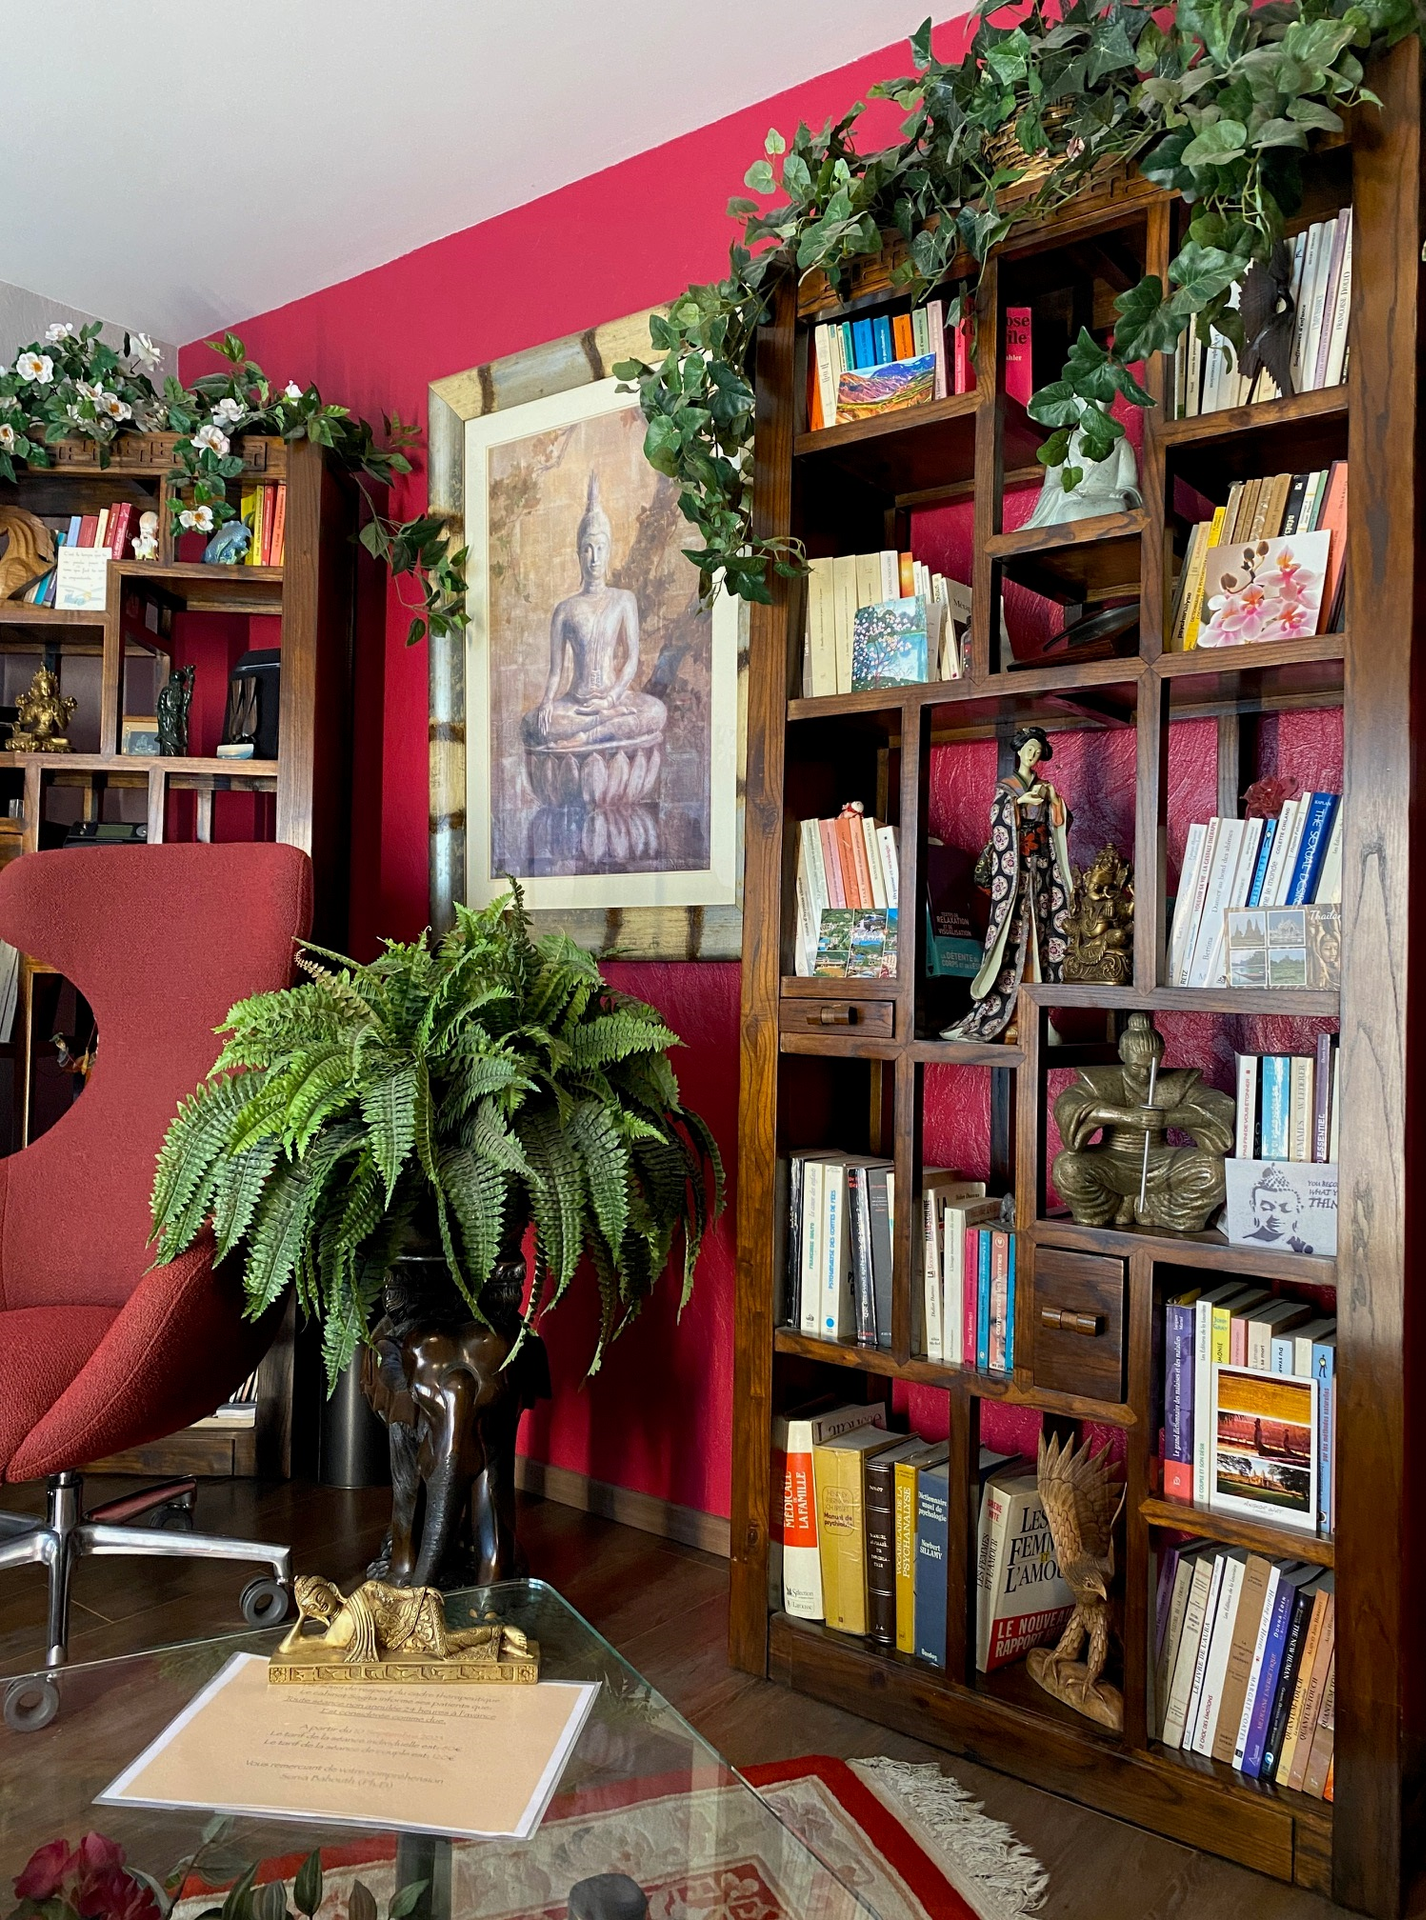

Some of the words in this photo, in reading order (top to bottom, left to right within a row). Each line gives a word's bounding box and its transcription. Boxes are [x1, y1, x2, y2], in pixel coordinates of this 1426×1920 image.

[1340, 271, 1350, 295] DOLTO
[1312, 808, 1324, 828] THE
[1275, 831, 1284, 854] COLETTE
[1280, 807, 1290, 830] CHILAND
[1301, 829, 1319, 870] SEXUAL
[1266, 860, 1278, 886] monde
[1211, 890, 1221, 912] Danser
[1218, 864, 1226, 880] bord
[1278, 1346, 1283, 1355] DU
[796, 1471, 807, 1514] FAMILLE
[898, 1485, 902, 1494] LA
[917, 1490, 947, 1509] Dictionnaire
[897, 1497, 902, 1510] DE
[916, 1504, 947, 1526] psychologie
[934, 1504, 943, 1513] de
[799, 1516, 807, 1528] LA
[1020, 1507, 1048, 1533] LES
[919, 1546, 942, 1560] SILLAMY
[921, 1539, 940, 1552] Norbert
[978, 1532, 990, 1570] FEMMES
[985, 1538, 998, 1578] L'AMOUR
[975, 1571, 984, 1587] LES
[984, 1578, 992, 1590] ET
[1263, 1589, 1274, 1616] Healing
[998, 1619, 1014, 1639] LE
[1019, 1606, 1074, 1634] NOUVEAU
[995, 1631, 1044, 1658] RAPPORT
[1200, 1622, 1210, 1650] L'AURA
[1257, 1628, 1266, 1650] Horses
[1198, 1652, 1205, 1663] DE
[1283, 1653, 1292, 1680] HUMAN
[1195, 1663, 1203, 1684] LIVRE
[1194, 1686, 1200, 1694] LE
[1244, 1675, 1256, 1710] MARGRIT
[418, 1706, 449, 1716] heures
[459, 1710, 497, 1720] l'avance
[1286, 1678, 1301, 1740] QUANTUM-TOUCH
[1300, 1677, 1317, 1741] QUANTUM-TOUCH
[1238, 1712, 1248, 1740] COATES
[270, 1762, 321, 1771] remerciant
[365, 1769, 443, 1784] compréhension
